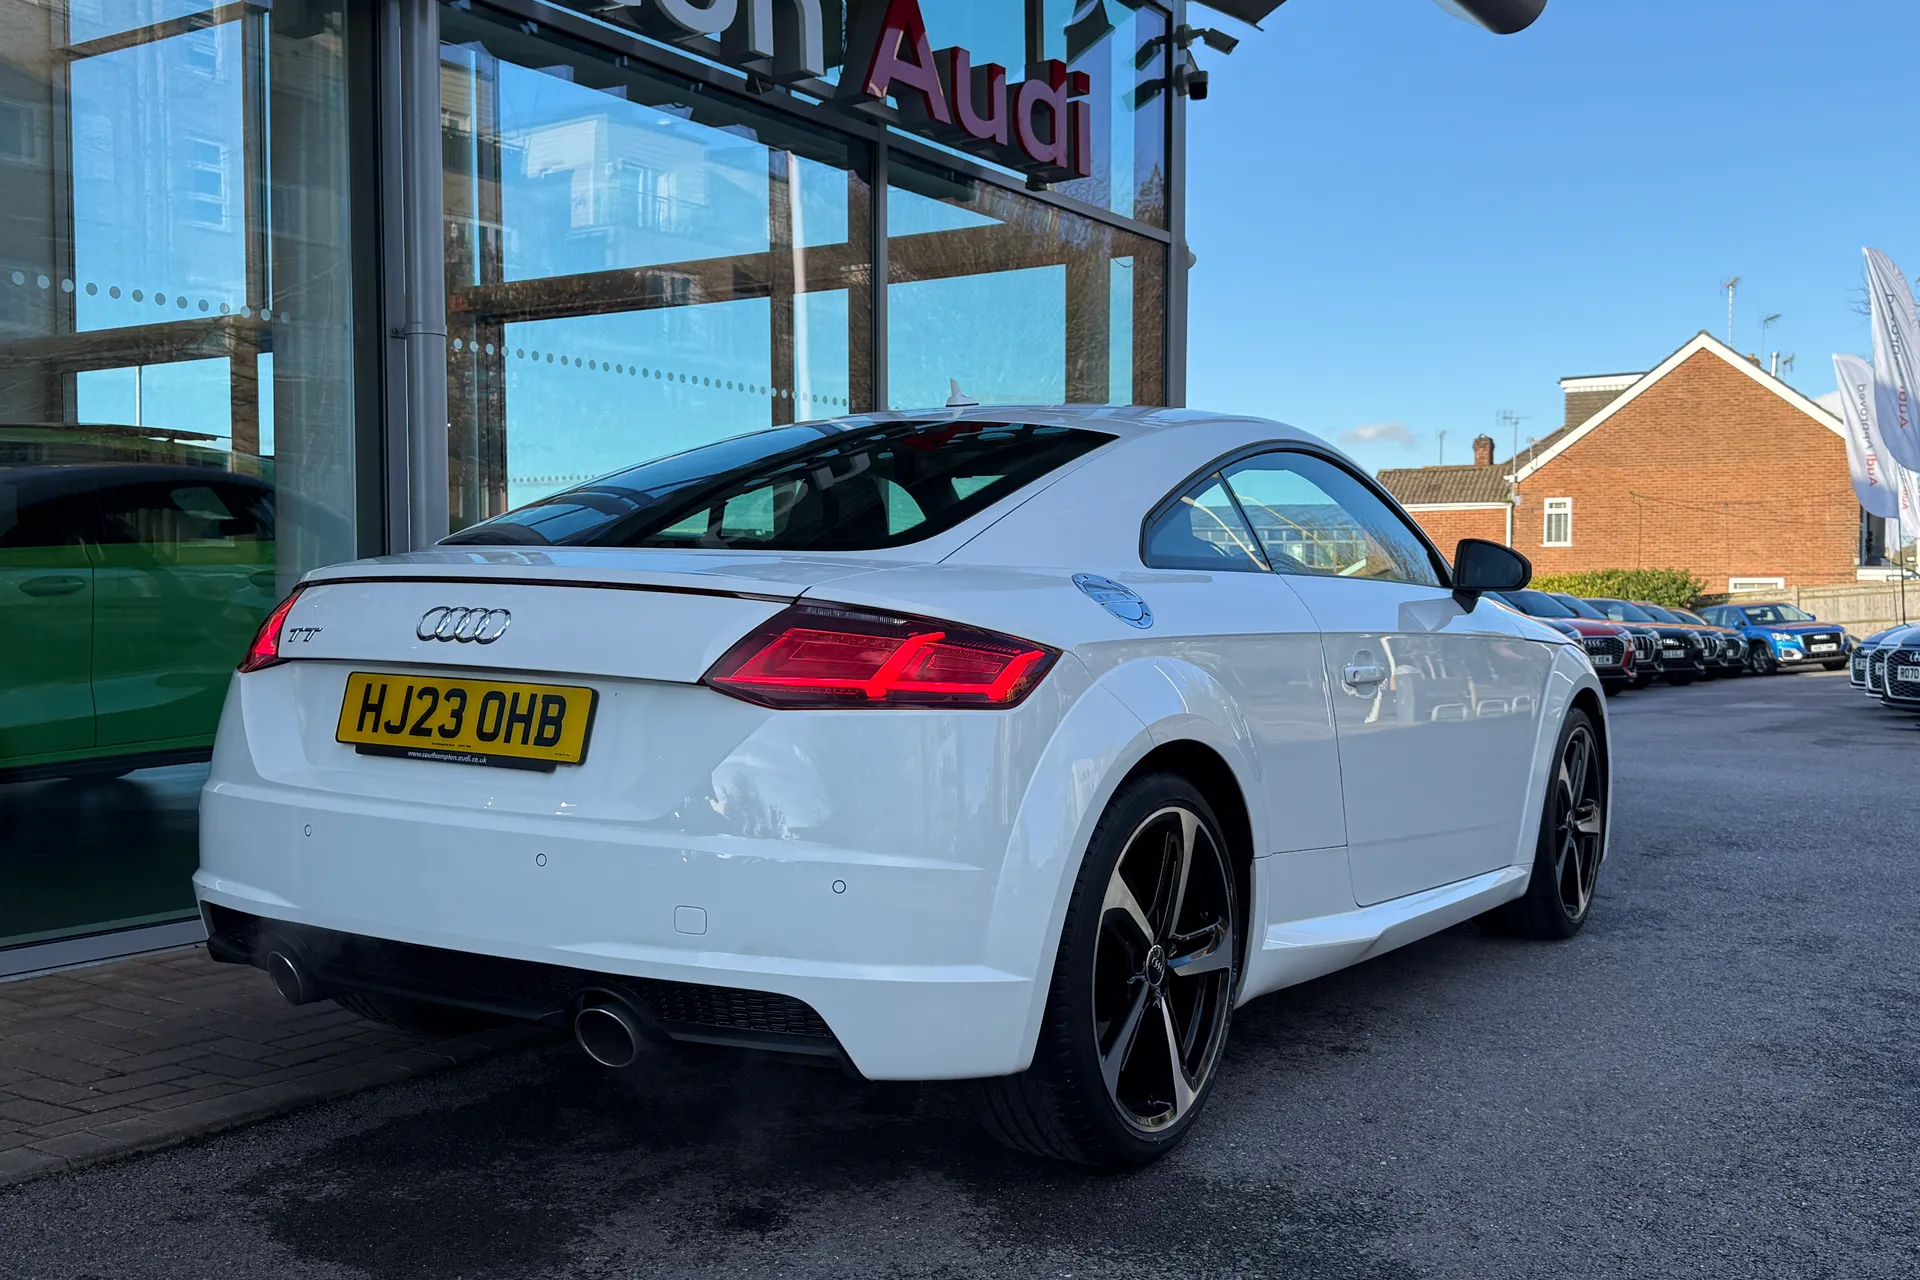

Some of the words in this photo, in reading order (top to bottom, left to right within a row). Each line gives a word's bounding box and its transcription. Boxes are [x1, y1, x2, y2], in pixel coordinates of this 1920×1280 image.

[861, 0, 1091, 177] Audi
[288, 627, 323, 643] TT
[356, 682, 467, 738] HJ23
[475, 690, 567, 747] OHB
[407, 750, 487, 764] www.southampton.audi.co.uk
